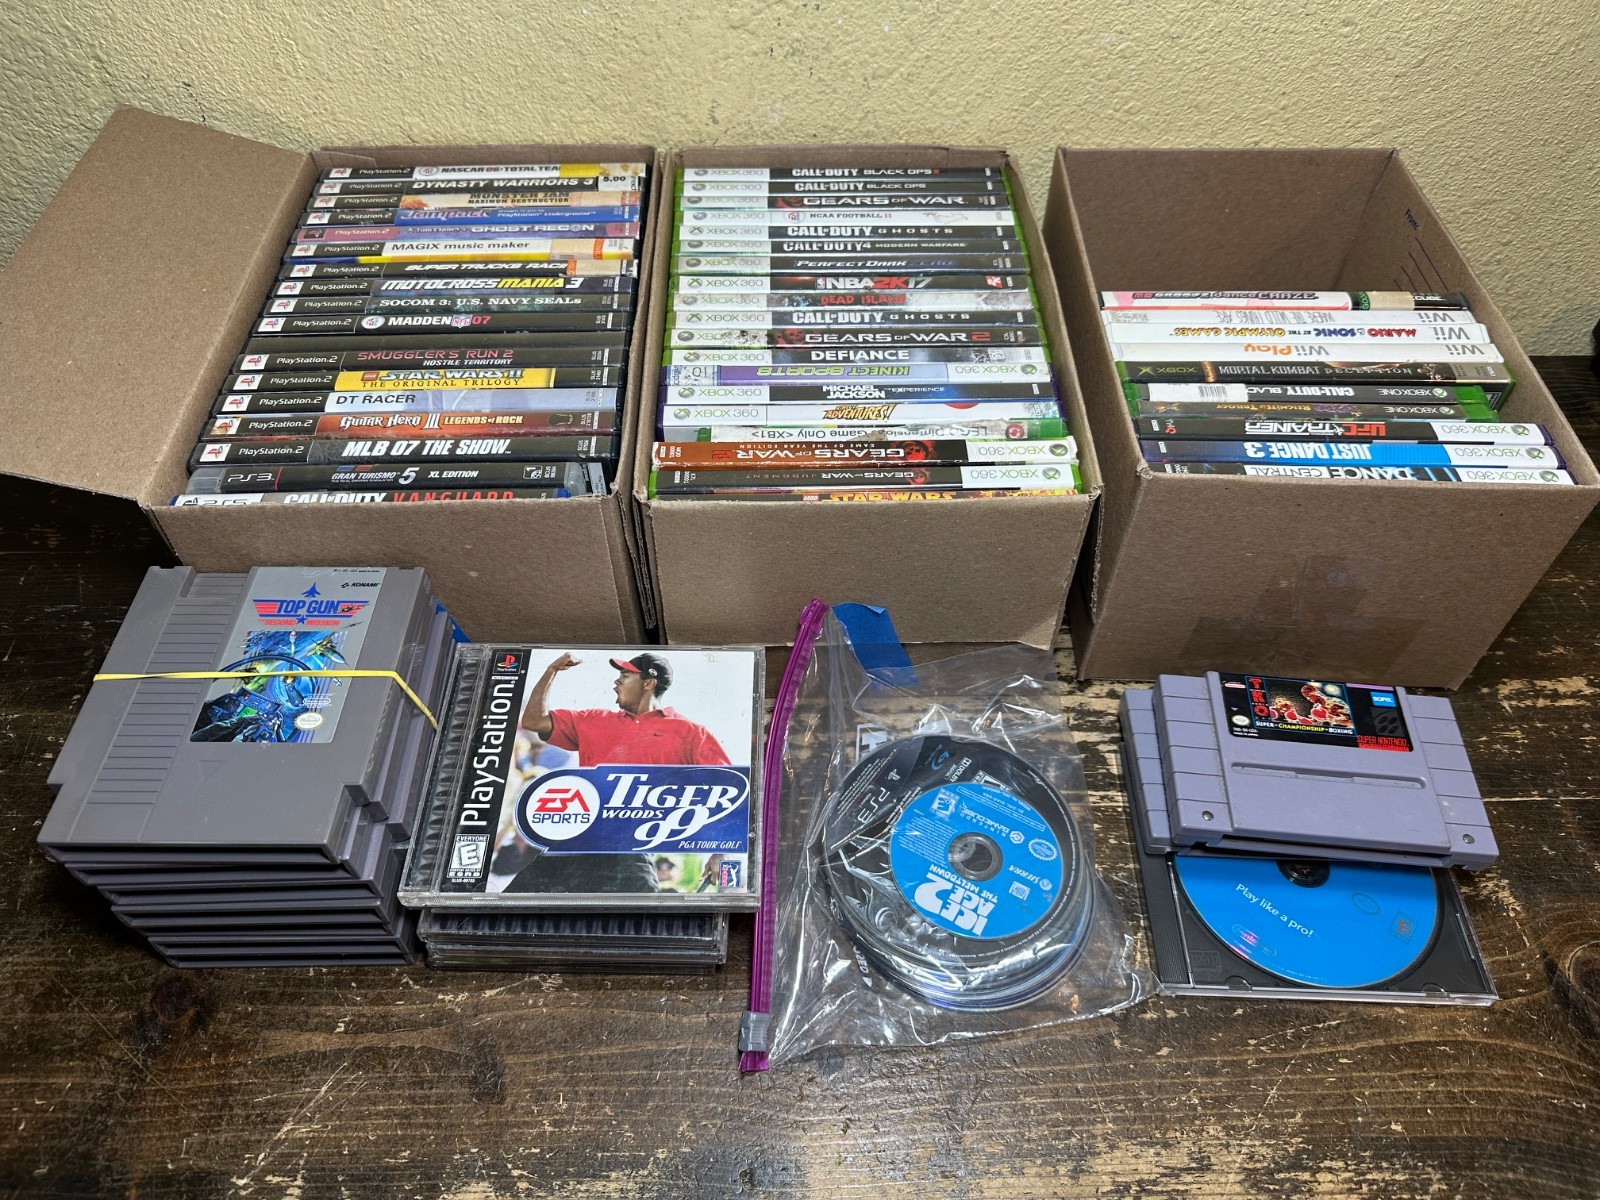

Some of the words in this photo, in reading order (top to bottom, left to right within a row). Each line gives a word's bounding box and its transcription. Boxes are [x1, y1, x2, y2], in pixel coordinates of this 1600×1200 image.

[792, 169, 821, 177] CALL
[412, 180, 489, 189] DYNASTY
[493, 178, 579, 187] WARRIORS
[583, 178, 594, 186] 3
[795, 183, 825, 191] CALL
[829, 182, 864, 191] DUTY
[803, 196, 889, 205] GEARS
[906, 196, 964, 205] WAR
[472, 225, 530, 233] GHOST
[535, 224, 595, 232] RECON
[787, 226, 824, 236] CALL
[829, 226, 873, 236] DUTY
[444, 242, 484, 250] music
[488, 241, 530, 249] maker
[783, 242, 818, 251] CALL
[565, 278, 584, 289] 3
[706, 279, 740, 287] XBOX
[741, 279, 763, 287] 360
[380, 299, 437, 307] SOCOM
[821, 295, 855, 305] DEAD
[388, 316, 452, 326] MADDEN
[472, 315, 491, 324] 07
[705, 314, 740, 322] XBOX
[742, 314, 765, 322] 360
[792, 312, 831, 324] CALL
[837, 312, 884, 323] DUTY
[1419, 312, 1455, 323] Wii
[1174, 327, 1222, 337] GAMES
[1224, 327, 1286, 337] OLYMPIC
[1313, 328, 1357, 337] SONIC
[1367, 328, 1417, 337] MARIO
[1434, 327, 1470, 340] Wii
[805, 333, 892, 343] GEARS
[910, 333, 968, 341] WAR
[1243, 343, 1292, 356] Play
[1294, 345, 1330, 356] Wii
[1445, 344, 1484, 355] Wii
[357, 351, 459, 360] SMUGGLER'S
[466, 350, 498, 358] RUN
[811, 350, 910, 361] DEFIANCE
[277, 357, 326, 365] PlayStation
[955, 365, 981, 374] 360
[984, 365, 1017, 374] XBOX
[1218, 366, 1269, 374] MORTAL
[1271, 366, 1320, 375] KOMBAT
[1324, 367, 1413, 375] DECEPTION
[379, 371, 443, 381] STAR
[444, 369, 503, 380] WARS
[393, 379, 457, 387] ORIGINAL
[464, 378, 520, 386] TRILOGY
[336, 395, 359, 405] DT
[362, 394, 416, 404] RACER
[826, 391, 886, 399] JACKSON
[259, 397, 313, 406] PlayStation
[694, 409, 731, 417] XBOX
[733, 408, 759, 417] 360
[444, 416, 488, 424] LEGENDS
[496, 415, 523, 424] ROCK
[1244, 421, 1336, 433] TRAINER
[1344, 423, 1386, 436] UFC
[751, 431, 793, 440] <XB1>
[797, 428, 826, 438] Only
[829, 428, 868, 438] Game
[239, 447, 294, 456] PlayStation
[341, 441, 389, 457] MLB
[391, 440, 421, 456] 07
[422, 440, 453, 455] THE
[455, 438, 511, 455] SHOW
[1243, 442, 1265, 458] 3
[1266, 442, 1329, 459] DANCE
[1331, 443, 1373, 460] JUST
[736, 450, 795, 459] WAR
[814, 448, 905, 459] GEARS
[228, 473, 272, 482] PS3
[331, 472, 357, 480] GRAN
[358, 471, 396, 479] TURISMO
[398, 466, 420, 485] 5
[428, 470, 440, 478] XL
[441, 470, 479, 478] EDITION
[970, 469, 997, 479] 360
[1001, 468, 1039, 478] XBOX
[276, 600, 306, 614] TOP
[307, 600, 340, 614] GUN
[1255, 720, 1275, 728] SUPER
[1278, 723, 1325, 732] CHAMPIONSHIP
[1357, 735, 1377, 744] SUPER
[1377, 736, 1408, 747] NINTENDO
[459, 683, 515, 826] PlayStation
[535, 788, 590, 812] EA
[857, 787, 891, 824] PS3
[532, 813, 590, 824] SPORTS
[602, 809, 664, 819] WOODS
[633, 805, 710, 851] 99
[678, 840, 695, 849] PGA
[696, 840, 718, 849] TOUR
[720, 840, 741, 849] GOLF
[460, 843, 479, 867] E
[929, 864, 980, 893] MELTDOWN
[913, 873, 952, 915] 2
[981, 890, 998, 904] THE
[949, 886, 996, 916] AGE
[1235, 883, 1260, 904] Play
[1259, 897, 1279, 916] like
[1280, 914, 1288, 922] a
[1288, 919, 1315, 938] pro!
[940, 900, 989, 936] ICE
